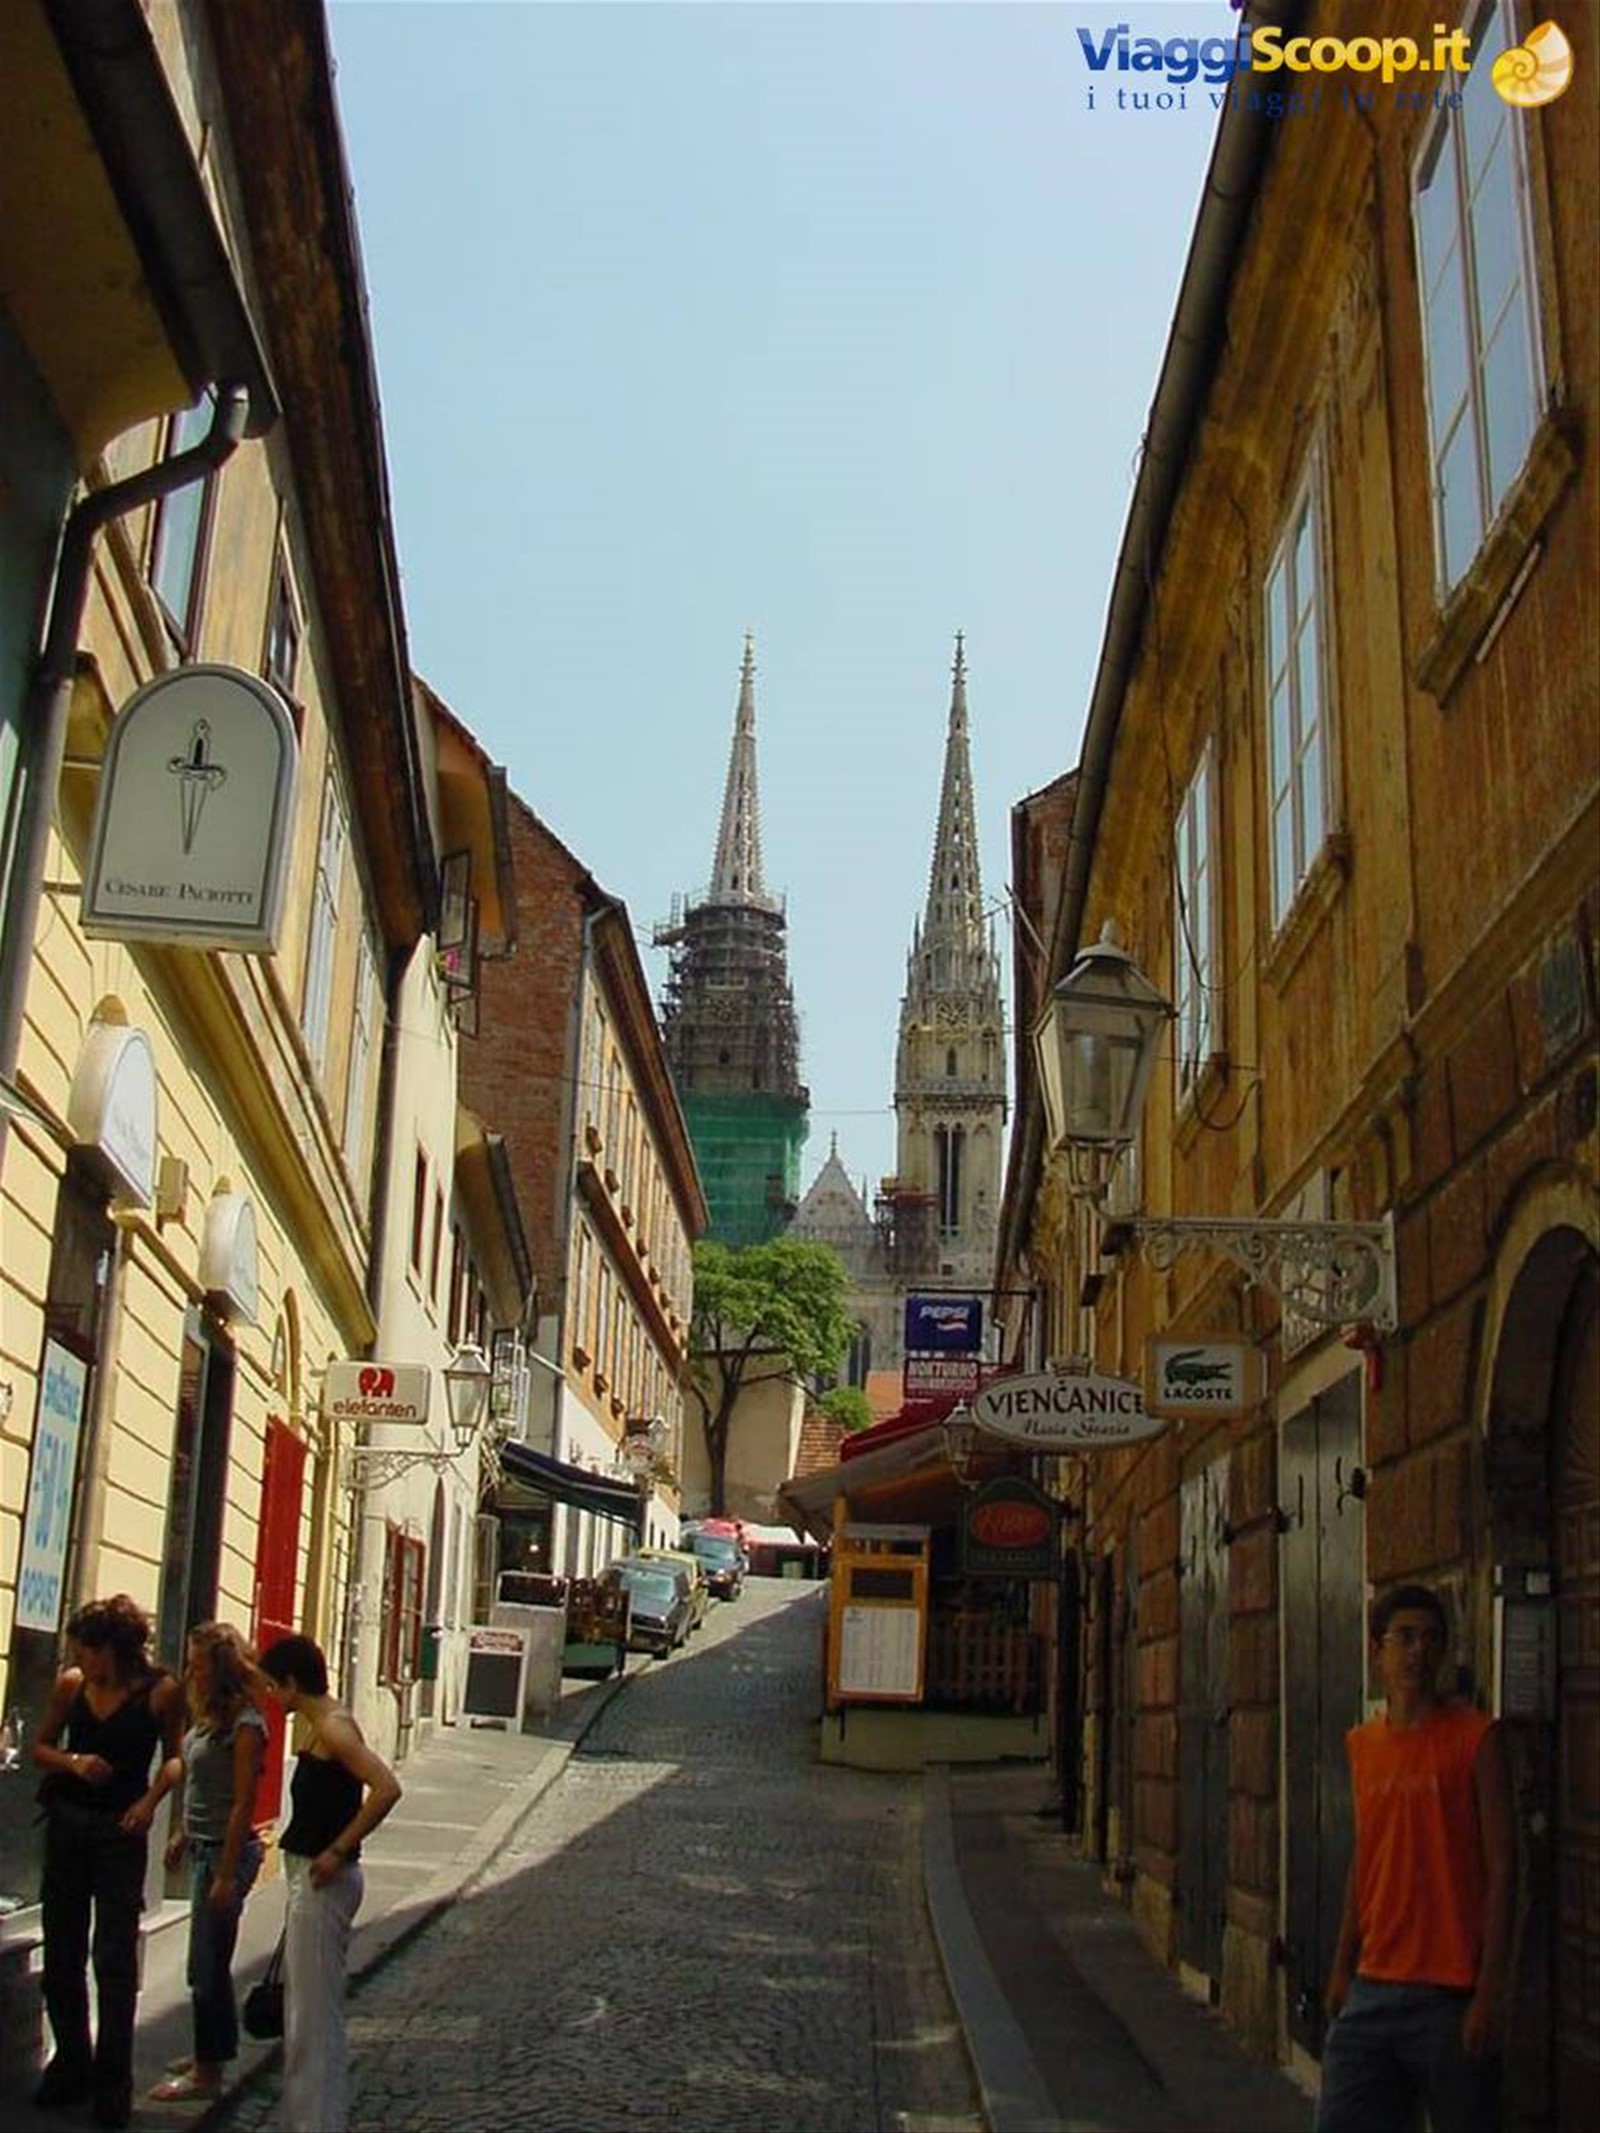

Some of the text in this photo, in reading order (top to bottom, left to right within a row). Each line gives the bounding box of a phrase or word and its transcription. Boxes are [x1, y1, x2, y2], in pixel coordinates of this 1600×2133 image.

[920, 1306, 969, 1319] PEPSI
[986, 1380, 1143, 1418] VJENČANICE
[1164, 1387, 1232, 1400] LACOSTE
[333, 1398, 417, 1418] elefanten
